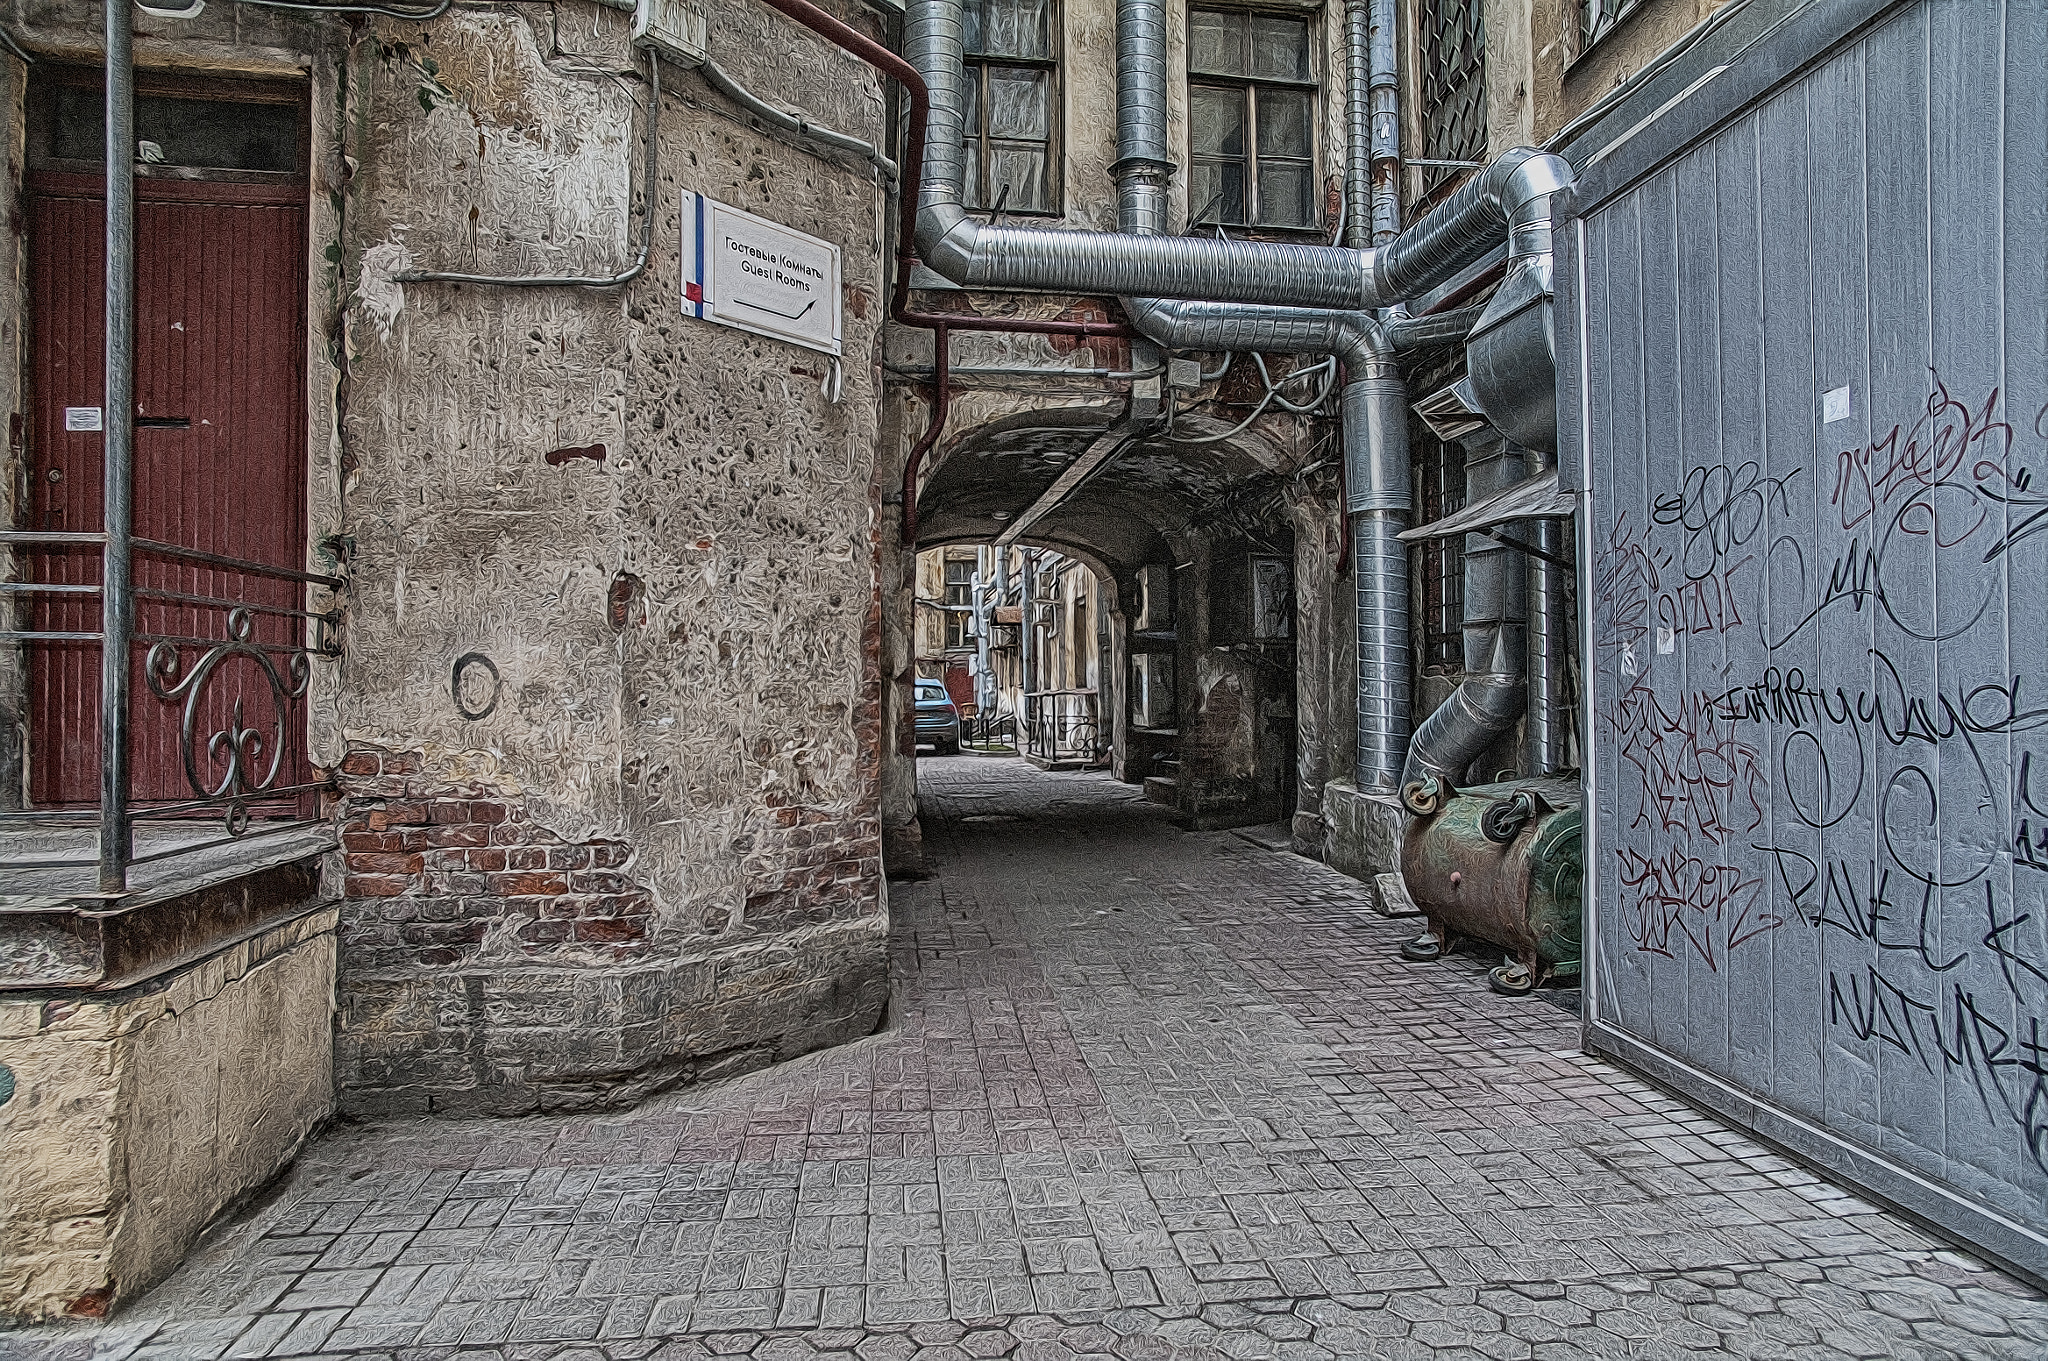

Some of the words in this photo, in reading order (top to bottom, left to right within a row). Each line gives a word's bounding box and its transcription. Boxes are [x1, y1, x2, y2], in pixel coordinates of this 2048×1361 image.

[725, 236, 777, 263] Гостевые
[779, 254, 824, 280] Комнаты
[741, 260, 773, 281] Guest
[775, 270, 811, 292] Rooms
